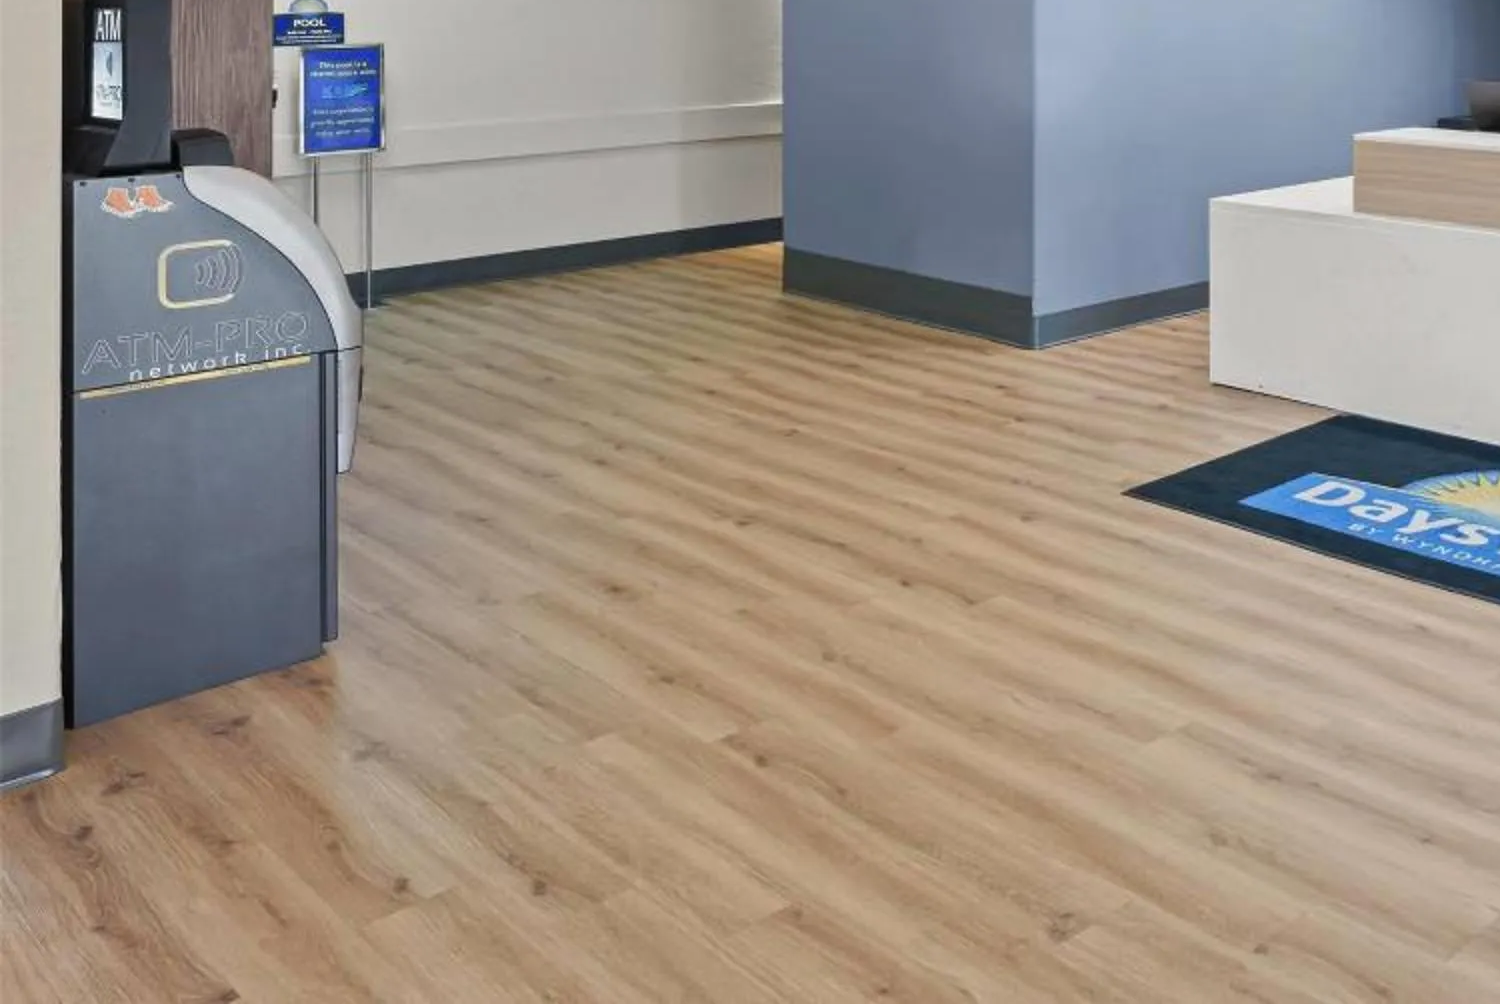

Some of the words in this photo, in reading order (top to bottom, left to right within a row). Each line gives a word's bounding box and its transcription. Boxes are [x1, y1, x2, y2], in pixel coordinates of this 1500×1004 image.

[95, 8, 121, 41] ATM
[293, 18, 327, 28] POOL
[81, 310, 309, 375] ATM-PRO
[129, 352, 248, 383] network
[1347, 522, 1386, 537] BY
